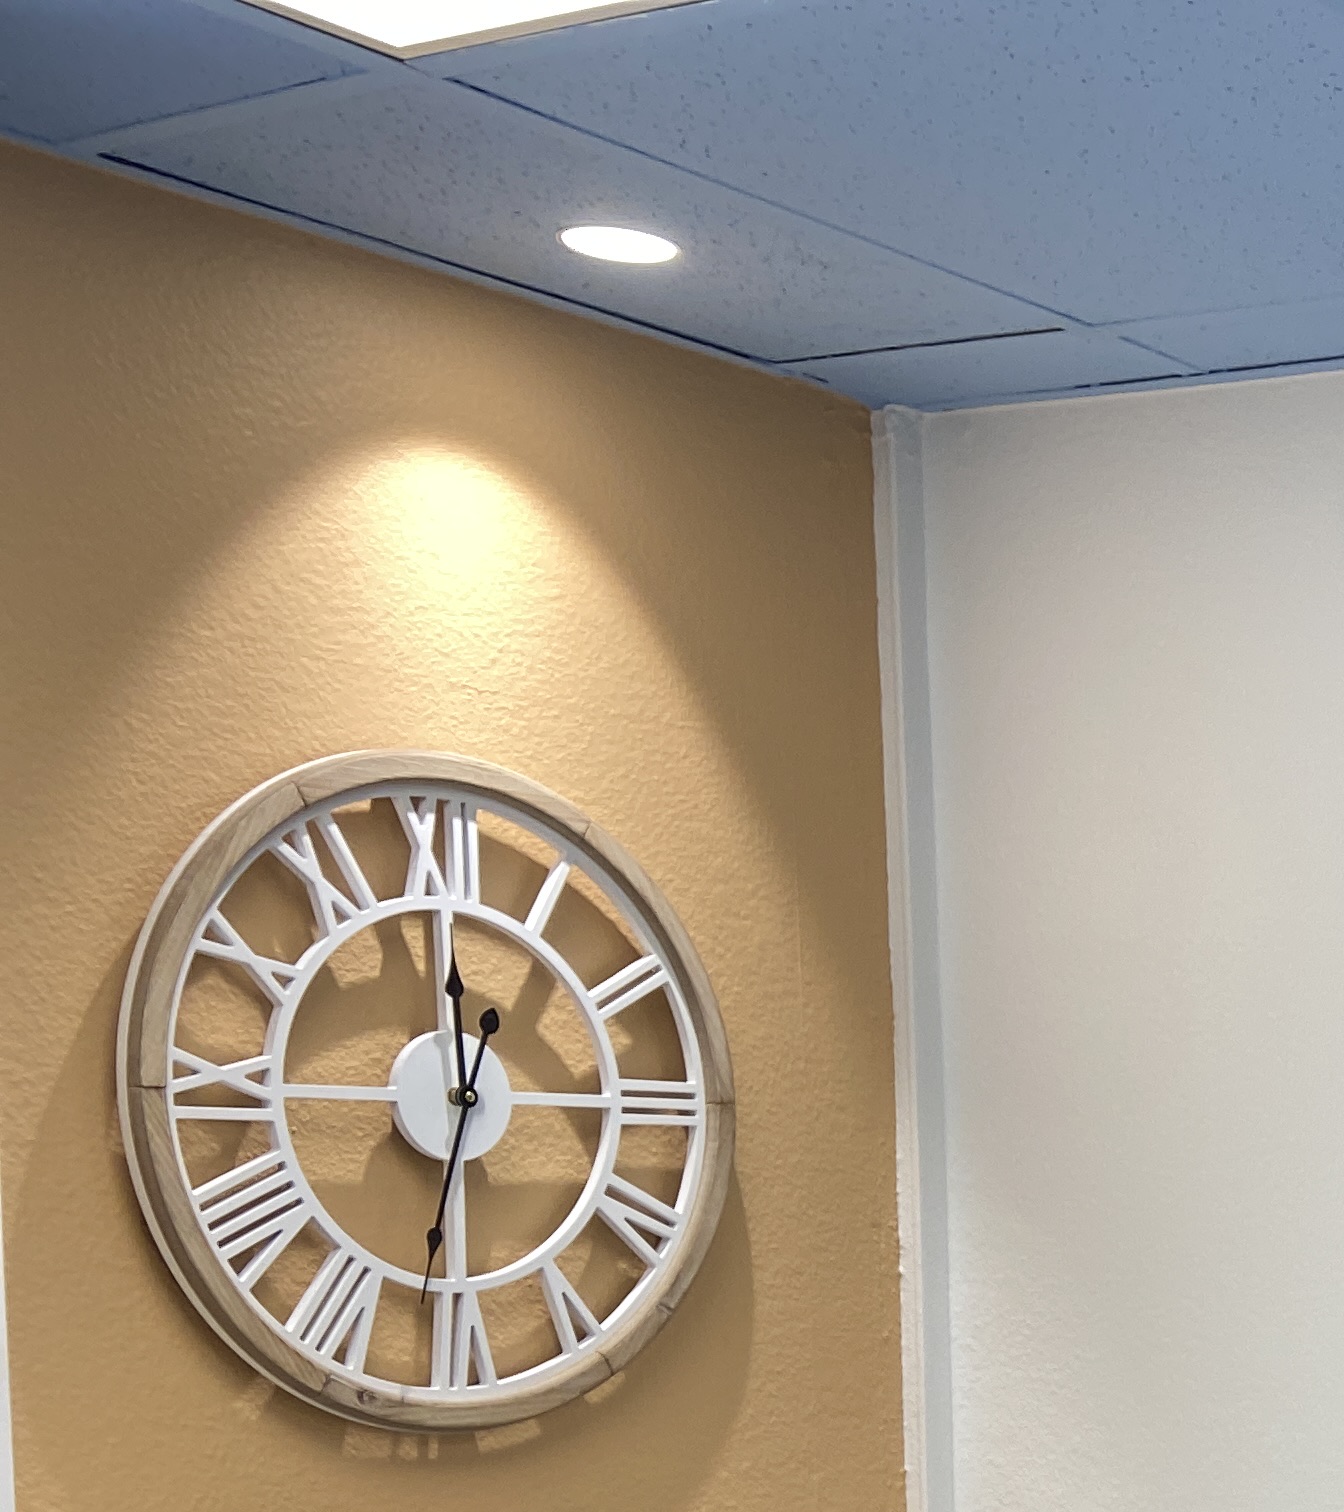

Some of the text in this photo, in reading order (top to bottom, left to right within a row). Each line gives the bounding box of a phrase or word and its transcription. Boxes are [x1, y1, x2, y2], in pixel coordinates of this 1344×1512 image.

[266, 810, 379, 936] XI
[390, 794, 479, 904] XII
[522, 858, 573, 935] I
[194, 906, 302, 1006] X
[587, 952, 671, 1019] II
[172, 1046, 275, 1122] IX
[618, 1079, 699, 1126] III
[189, 1149, 315, 1291] VIII
[596, 1178, 684, 1268] IV
[284, 1247, 384, 1375] VII
[430, 1289, 497, 1390] VI
[541, 1263, 604, 1355] V
